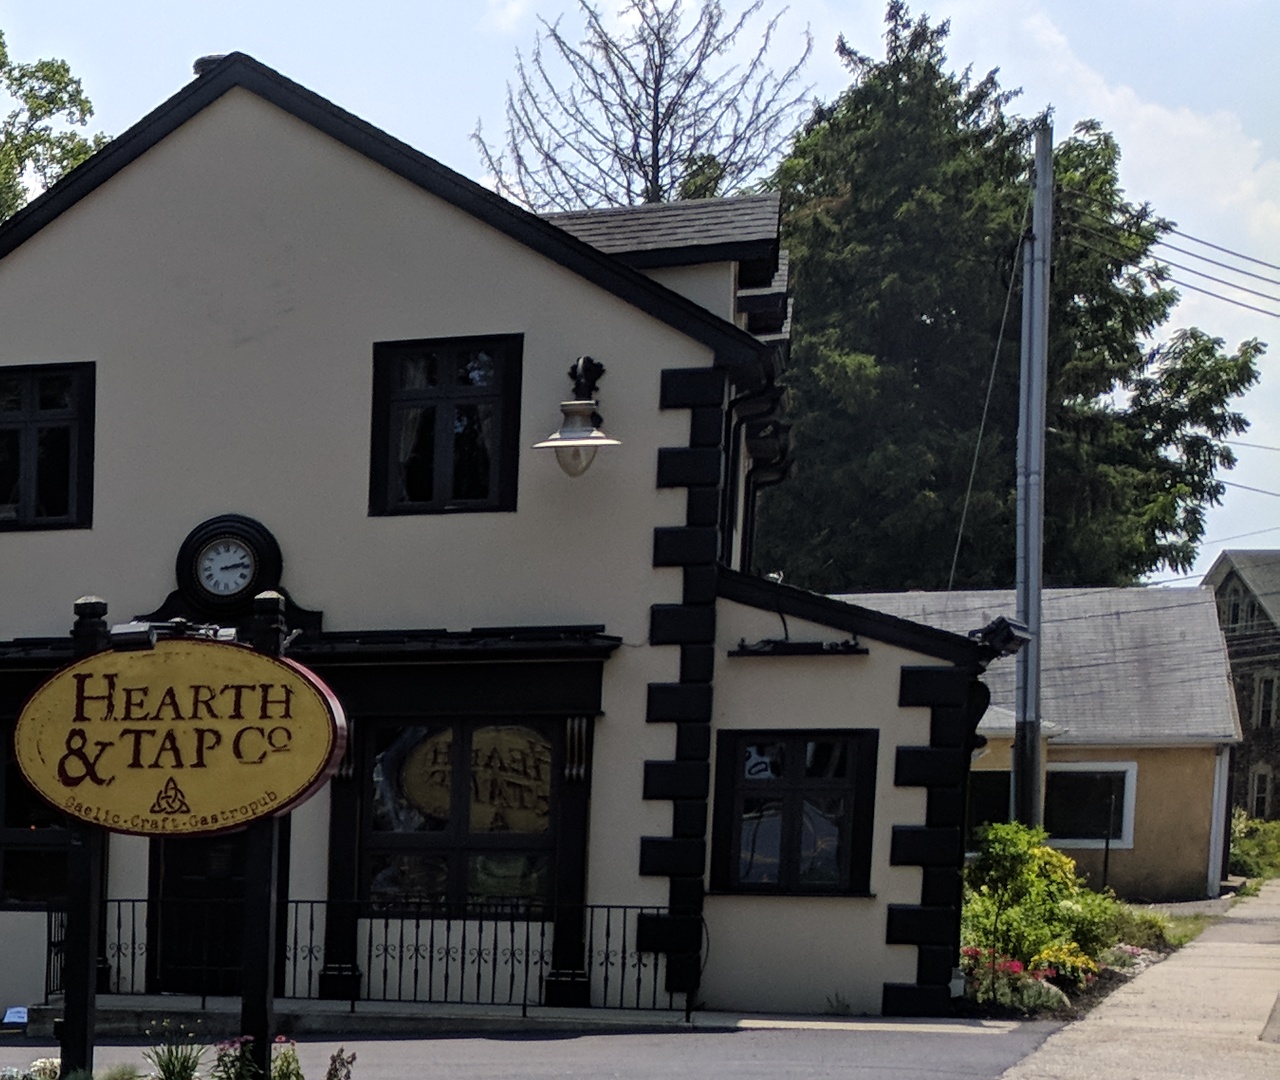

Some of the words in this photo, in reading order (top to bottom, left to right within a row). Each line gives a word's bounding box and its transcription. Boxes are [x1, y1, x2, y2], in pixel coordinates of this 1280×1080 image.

[72, 673, 294, 723] HEARTH
[57, 728, 115, 787] &
[119, 728, 222, 769] TAP
